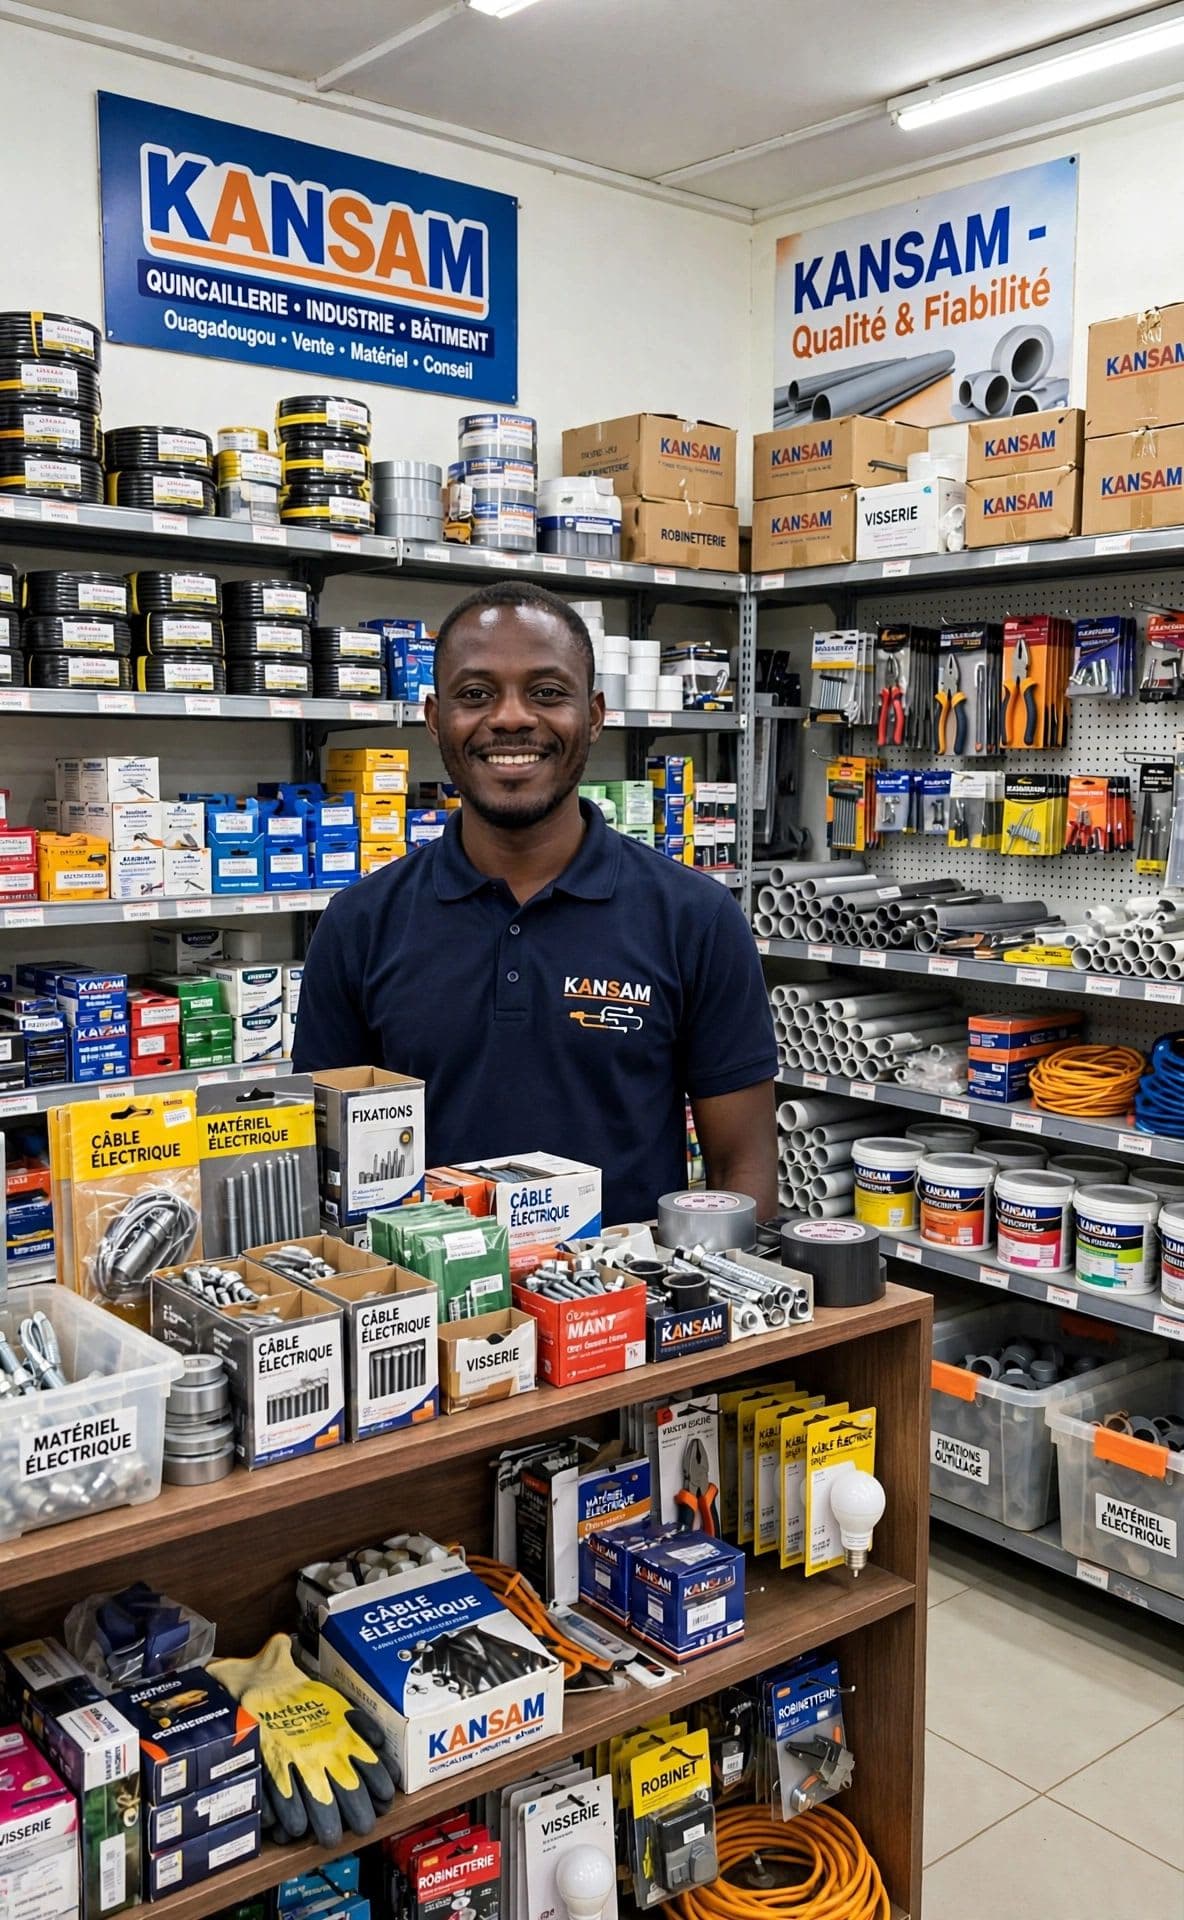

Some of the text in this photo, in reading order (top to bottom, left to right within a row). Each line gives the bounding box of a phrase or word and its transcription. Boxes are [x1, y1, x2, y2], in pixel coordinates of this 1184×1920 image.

[147, 152, 483, 298] KANSAM
[794, 206, 1010, 314] KANSAM
[146, 269, 489, 351] QUINCAILLERIE INDUSTRIE BÂTIMENT
[792, 268, 1051, 360] Qualité & Fiabilité
[164, 310, 473, 380] Ouagadougou Vente Matériel Conseil
[660, 437, 721, 462] KANSAM
[771, 440, 833, 466] KANSAM
[985, 430, 1056, 458] KANSAM
[1101, 467, 1182, 496] KANSAM
[864, 506, 918, 527] VISSERIE
[983, 490, 1053, 515] KANSAM
[771, 510, 832, 534] KANSAM
[661, 528, 726, 547] ROBINETTERIE
[564, 976, 651, 1002] KANSAM
[207, 1116, 272, 1136] MATÉRIEL
[352, 1105, 413, 1123] FIXATIONS
[91, 1130, 140, 1149] CÂBLE
[208, 1129, 288, 1151] ÉLECTRIQUE
[91, 1143, 181, 1169] ÉLECTRIQUE
[510, 1188, 552, 1210] CÂBLE
[510, 1204, 570, 1228] ÉLECTRIQUE
[361, 1307, 400, 1328] CÂBLE
[361, 1315, 431, 1344] ÉLECTRIQUE
[661, 1313, 723, 1343] KANSAM
[258, 1335, 299, 1356] CÂBLE
[258, 1344, 333, 1374] ÉLECTRIQUE
[467, 1348, 519, 1372] VISSERIE
[34, 1417, 119, 1453] MATÉRIEL
[26, 1433, 132, 1476] ÉLECTRIQUE
[936, 1438, 981, 1463] FIXATIONS
[935, 1452, 983, 1478] OUTILLAGE
[1106, 1502, 1164, 1533] MATÉRIEL
[1101, 1514, 1171, 1550] ÉLECTRIQUE
[358, 1594, 482, 1643] ÉLECTRIQUE
[363, 1594, 433, 1625] CÂBLE
[428, 1692, 545, 1759] KANSAM
[641, 1761, 697, 1798] ROBINET
[540, 1803, 600, 1836] VISSERIE
[418, 1854, 495, 1890] ROBINETTERIE
